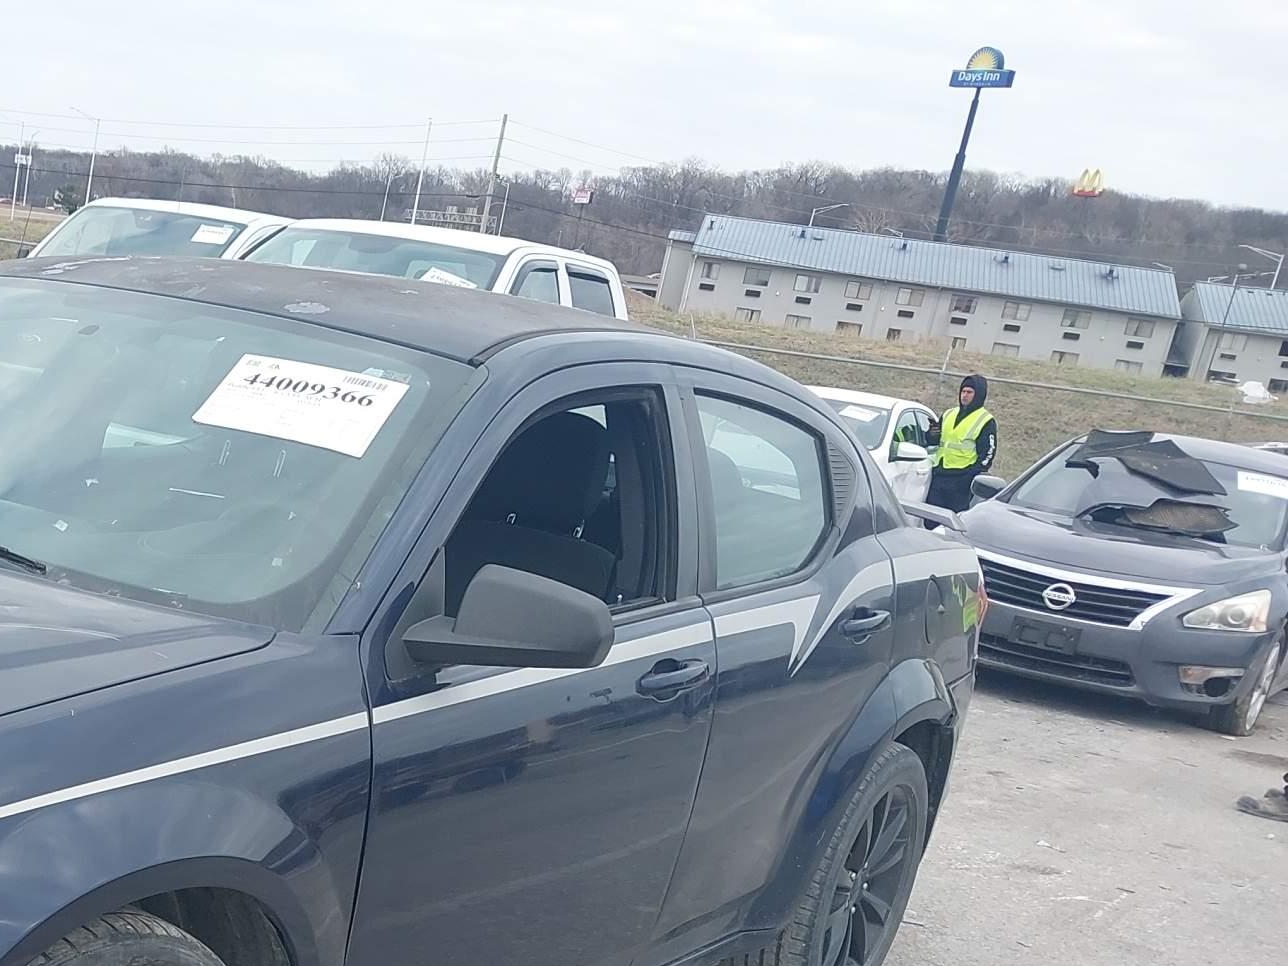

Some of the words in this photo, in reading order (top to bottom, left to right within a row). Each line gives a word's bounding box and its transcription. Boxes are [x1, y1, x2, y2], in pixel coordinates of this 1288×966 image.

[958, 71, 982, 82] Days
[983, 72, 1000, 81] Inn
[242, 372, 374, 408] 44009366
[1045, 592, 1074, 601] NISSAN
